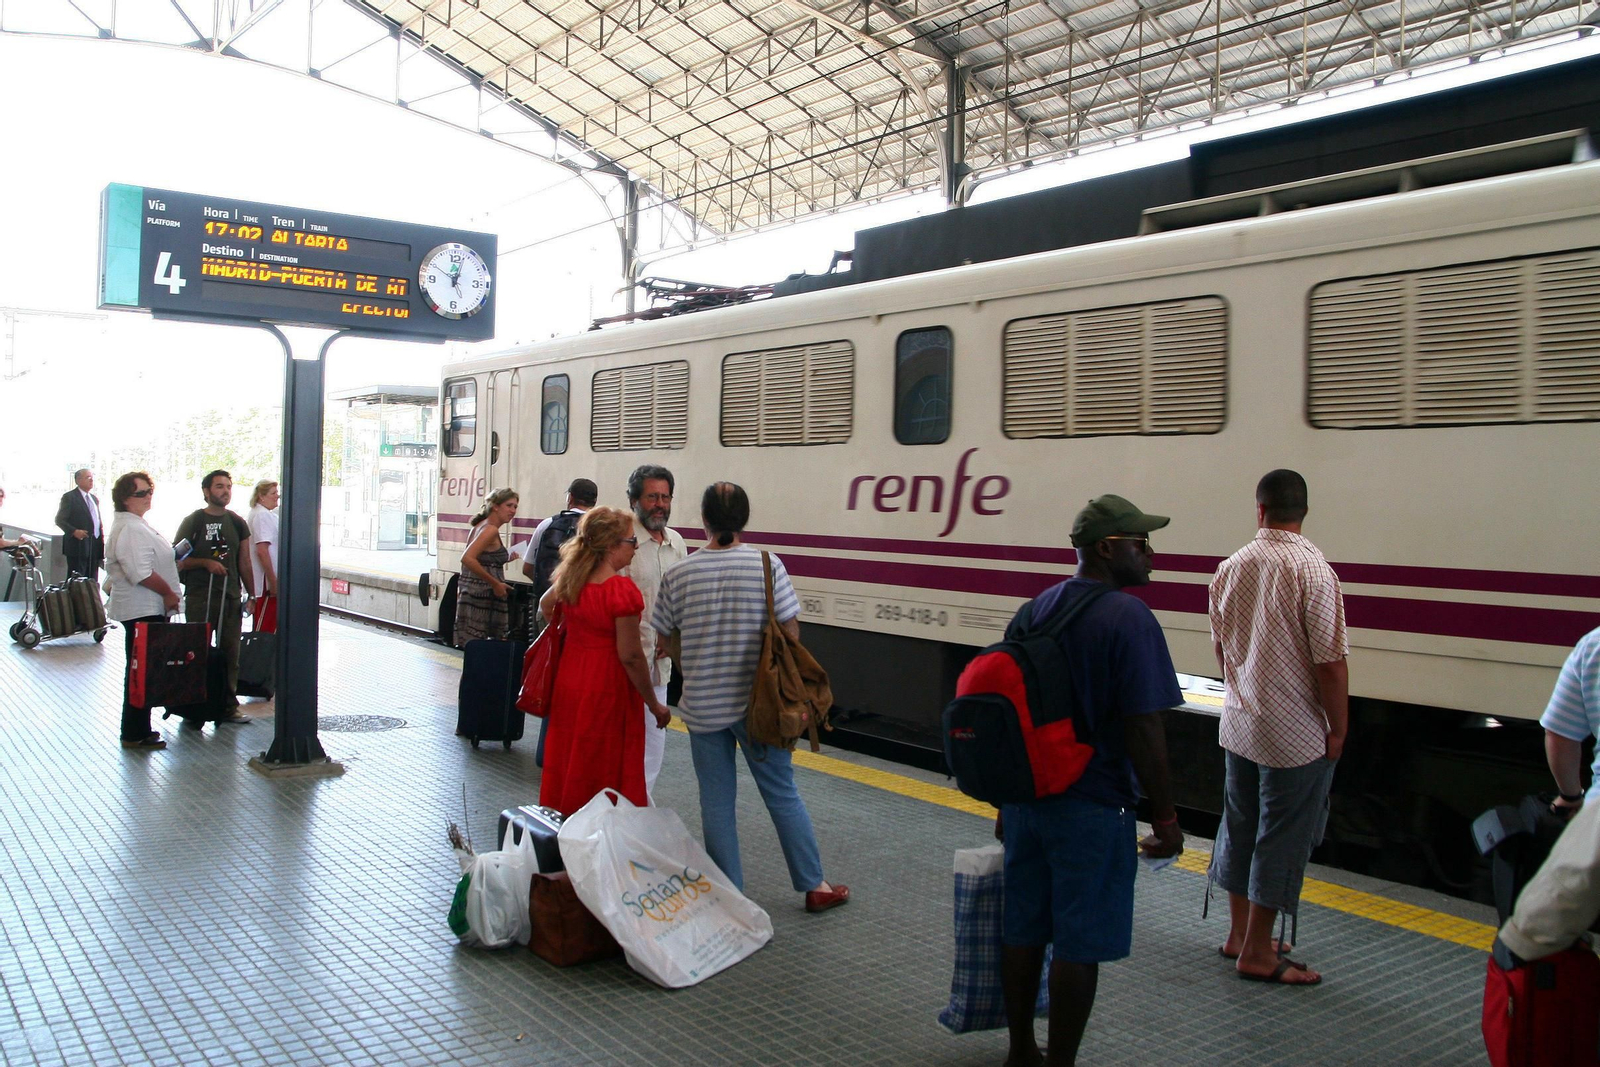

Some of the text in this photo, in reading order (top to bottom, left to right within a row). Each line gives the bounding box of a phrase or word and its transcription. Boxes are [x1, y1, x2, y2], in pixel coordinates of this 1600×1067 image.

[148, 200, 166, 212] Vía
[147, 217, 181, 228] PLATFORM
[203, 206, 259, 224] Hora TIME
[271, 215, 328, 232] Tren TRAIN
[202, 243, 299, 264] Destino DESTINATION
[450, 254, 462, 264] 12
[154, 251, 187, 295] 4
[428, 275, 436, 284] 9
[356, 274, 378, 293] DE
[472, 280, 480, 289] 3
[449, 301, 458, 310] 6
[440, 464, 485, 508] renfe
[847, 447, 1011, 538] renfe
[874, 603, 948, 627] 269-418-0
